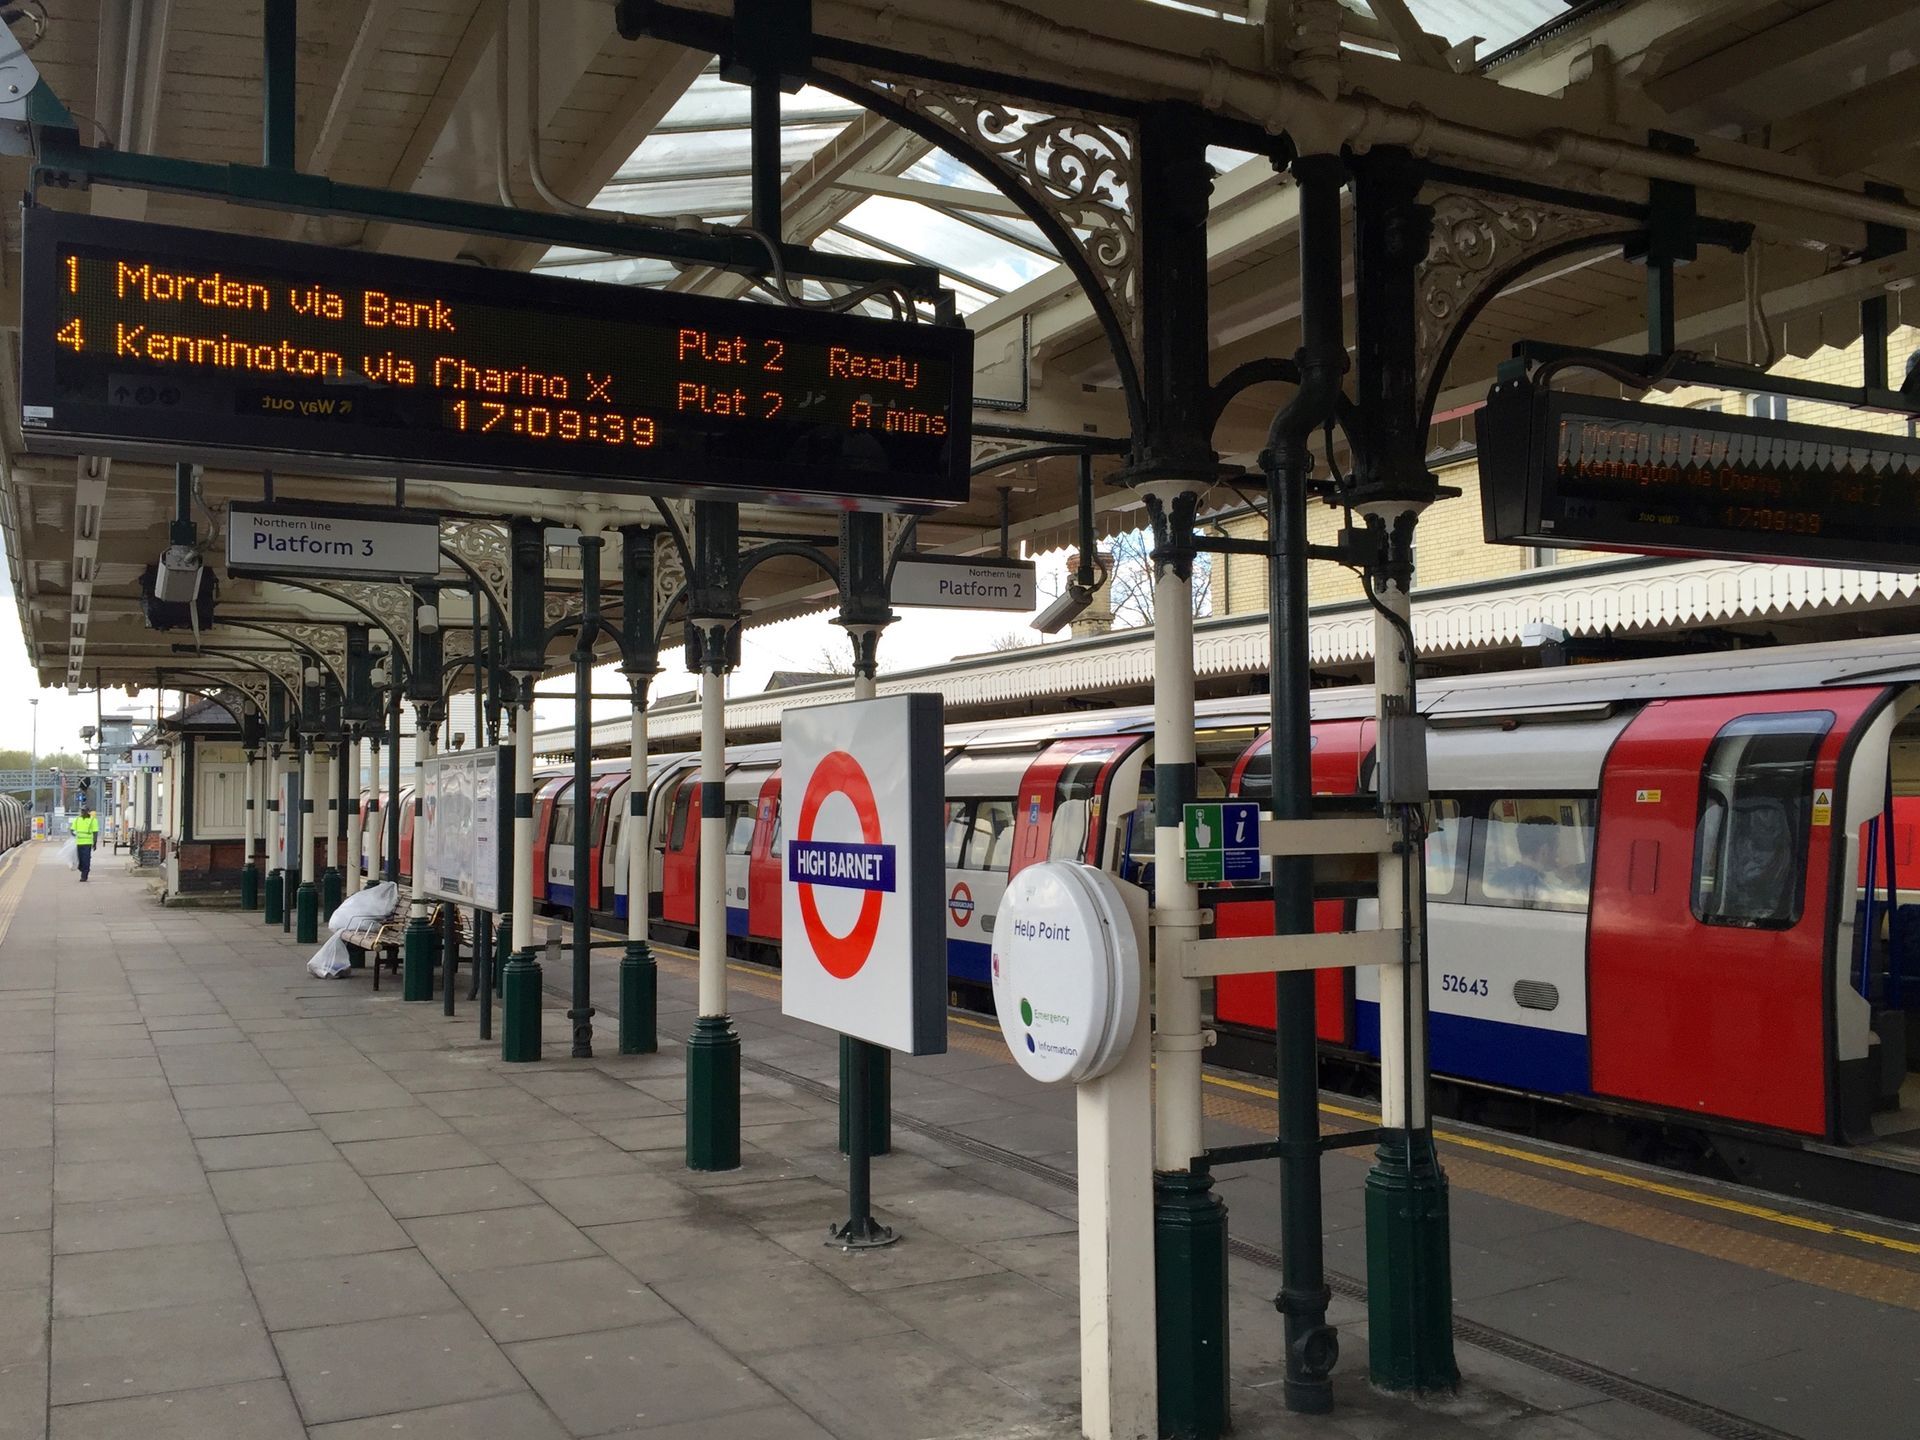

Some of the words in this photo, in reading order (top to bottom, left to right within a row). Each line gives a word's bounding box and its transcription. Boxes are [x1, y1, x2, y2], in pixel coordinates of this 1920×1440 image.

[66, 255, 78, 293] 1
[117, 260, 270, 312] Morden
[290, 284, 344, 320] via
[363, 290, 456, 332] Bank
[678, 328, 748, 366] Plat
[763, 339, 785, 373] 2
[829, 346, 920, 390] Ready
[56, 318, 84, 352] 4
[363, 350, 415, 385] via
[586, 372, 614, 403] X
[678, 382, 747, 417] Plat
[885, 406, 947, 436] mins
[452, 398, 656, 447] 17:09:39
[253, 516, 307, 530] Northern
[310, 518, 332, 531] line
[253, 532, 353, 555] Platform
[361, 540, 374, 557] 3
[968, 568, 1005, 579] Northern
[1007, 570, 1021, 580] line
[939, 580, 1008, 598] Platform
[1013, 583, 1021, 598] 2
[797, 849, 827, 877] HIGH
[829, 851, 884, 882] BARNET
[1014, 919, 1036, 942] Help
[1038, 921, 1070, 942] Point
[1442, 973, 1489, 997] 52643
[1034, 1008, 1070, 1026] Emergency
[1037, 1040, 1079, 1057] Information
